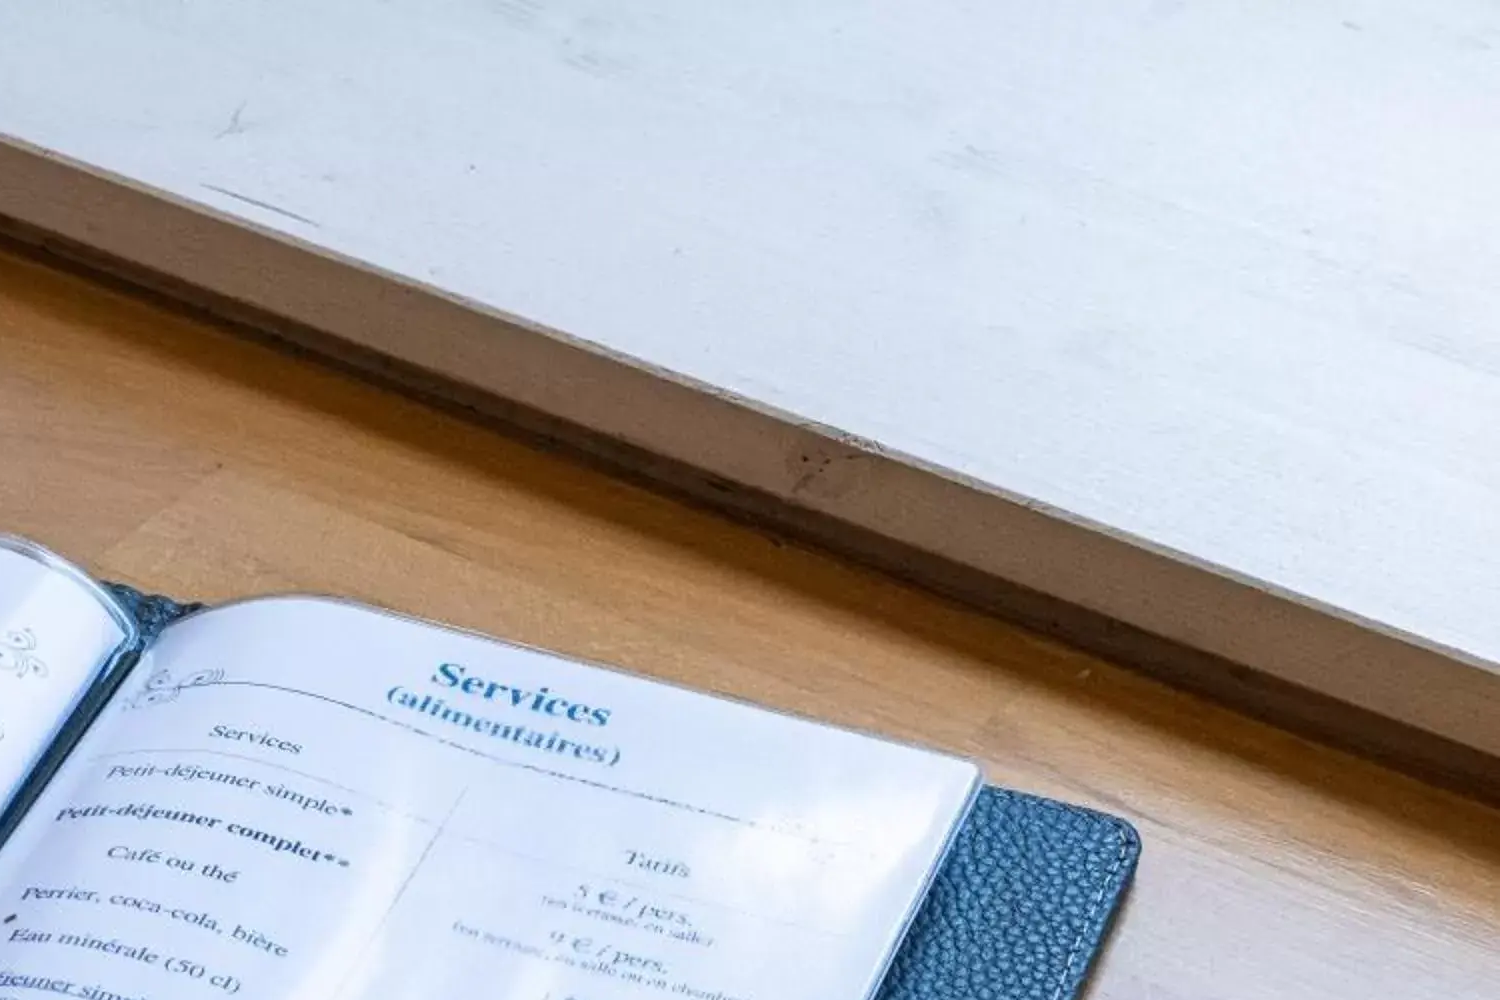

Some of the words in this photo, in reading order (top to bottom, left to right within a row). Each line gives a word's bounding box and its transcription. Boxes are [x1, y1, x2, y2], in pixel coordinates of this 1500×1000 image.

[430, 661, 613, 728] Services
[208, 723, 304, 756] Services
[386, 684, 623, 768] (alimentaires)
[106, 763, 261, 790] Petit-déjeuner
[55, 802, 223, 830] Petit-déjeuner
[106, 843, 163, 865] Café
[164, 856, 196, 873] ou
[200, 863, 241, 885] thé
[624, 848, 693, 880] Tarifs
[20, 886, 102, 906] Perrier,
[108, 891, 224, 934] coca-cola,
[230, 923, 290, 958] bière
[598, 890, 619, 906] €
[638, 904, 694, 930] pers.
[8, 926, 53, 944] Eau
[56, 931, 159, 965] minérale
[163, 954, 207, 980] (50
[209, 972, 242, 996] cl)
[572, 936, 595, 952] €
[612, 949, 671, 976] pers.
